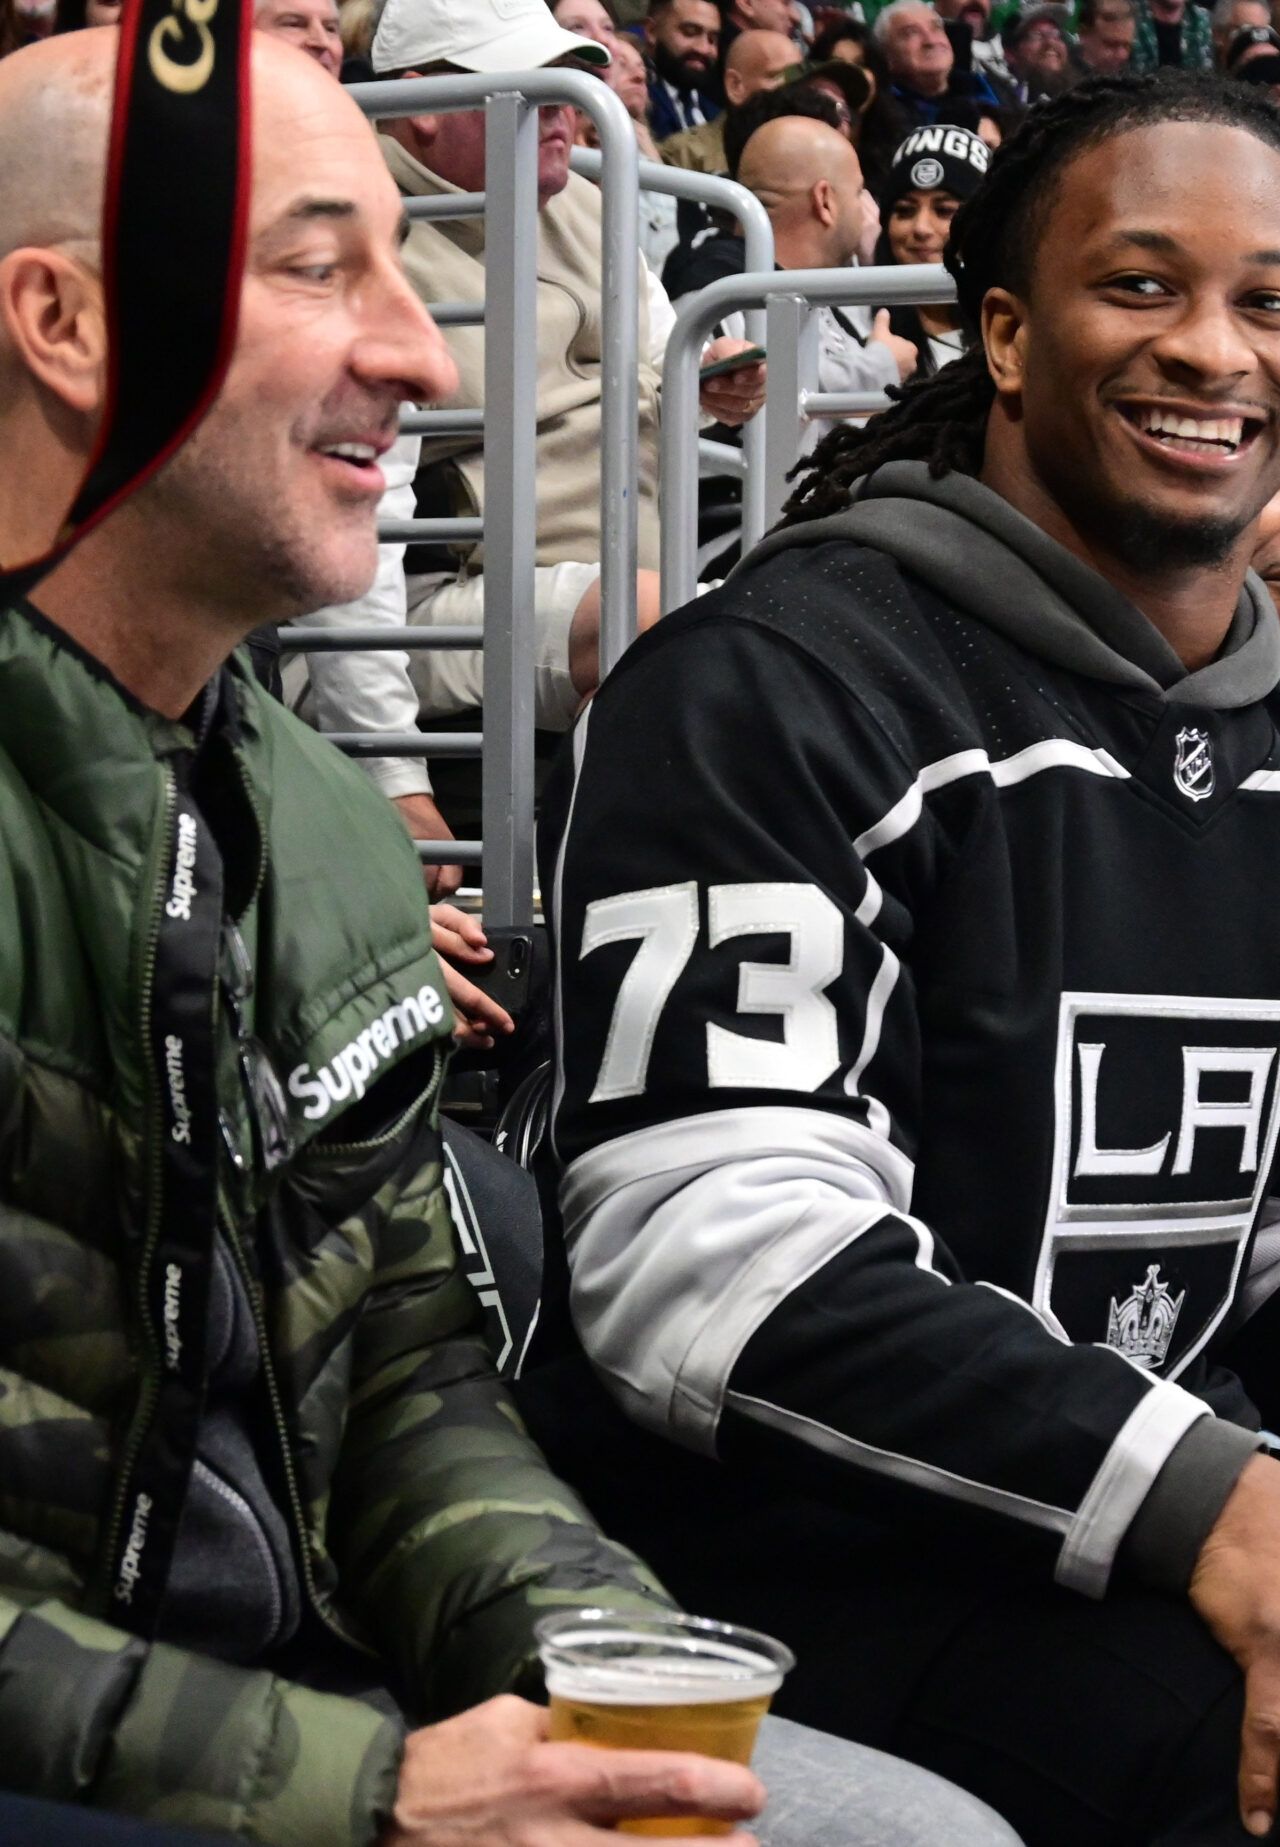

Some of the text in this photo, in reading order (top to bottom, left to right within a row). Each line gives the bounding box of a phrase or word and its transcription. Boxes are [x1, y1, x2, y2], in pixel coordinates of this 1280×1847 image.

[166, 813, 198, 921] Supreme
[288, 985, 444, 1120] Supreme
[579, 880, 845, 1103] 73
[165, 1034, 191, 1144] Supreme
[1074, 1042, 1278, 1177] LA
[114, 1493, 152, 1605] Supreme
